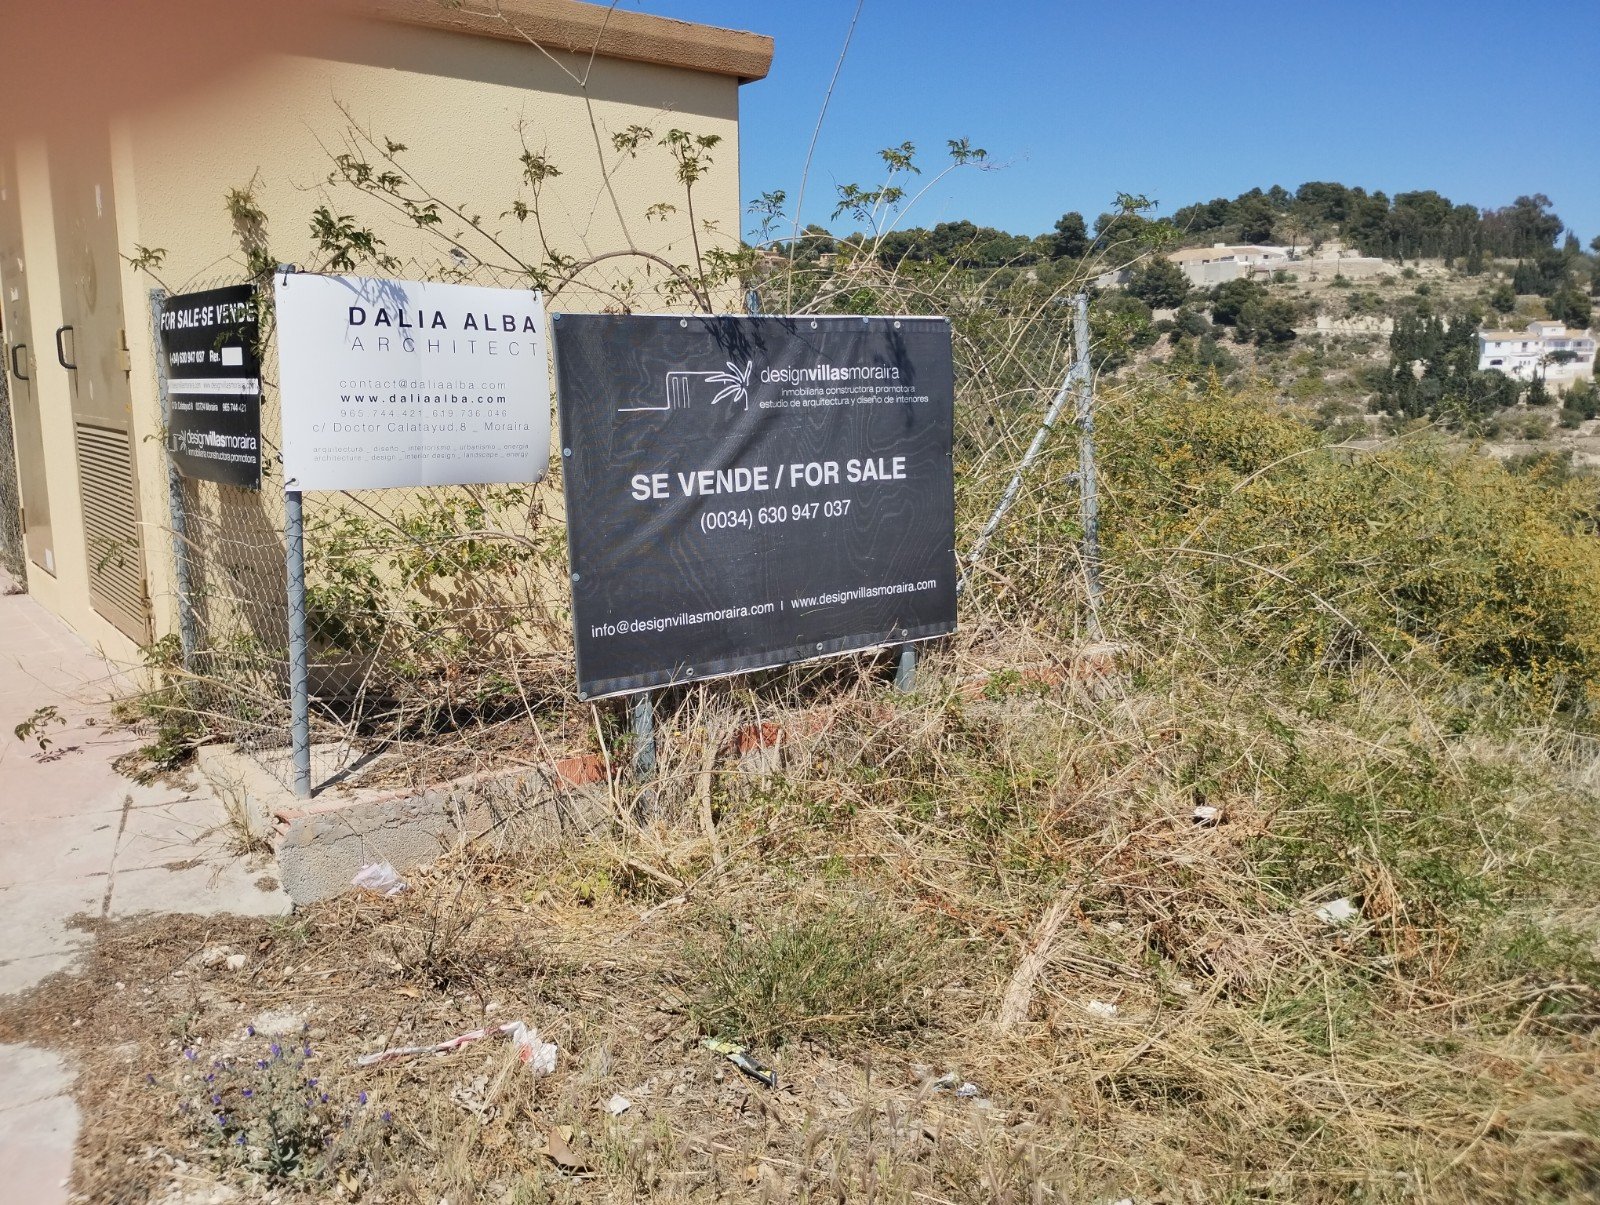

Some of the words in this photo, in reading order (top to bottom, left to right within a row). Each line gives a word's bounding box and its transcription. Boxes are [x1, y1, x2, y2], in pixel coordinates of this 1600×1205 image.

[160, 310, 176, 331] FOR
[349, 306, 448, 330] DALIA
[463, 312, 537, 334] ALBA
[351, 336, 538, 357] ARCHITECT
[339, 379, 507, 391] contact@daliaalba.com
[760, 363, 900, 386] designvillasmoraira
[340, 393, 507, 404] www.daliaalba.com
[759, 399, 788, 409] estudio
[790, 399, 801, 408] de
[802, 397, 850, 408] arquitectura
[850, 397, 856, 407] y
[856, 395, 883, 404] diseño
[883, 395, 895, 404] de
[895, 394, 929, 404] interiores
[781, 387, 825, 397] inmobiliaria
[825, 386, 874, 395] constructora
[875, 385, 916, 394] promotora
[312, 422, 326, 433] c/
[333, 422, 382, 433] Doctor
[484, 421, 531, 432] Moraira
[186, 429, 257, 450] designvillasmoraira
[631, 473, 670, 501] SE
[678, 466, 769, 497] VENDE
[774, 464, 784, 489] /
[790, 461, 840, 489] FOR
[846, 456, 907, 483] SALE
[700, 507, 753, 534] (0034)
[758, 505, 787, 525] 630
[792, 503, 820, 522] 947
[824, 500, 851, 519] 037
[591, 602, 775, 638] info@designvillasmoraira.com
[791, 579, 937, 609] www.designvillasmoraira.com
